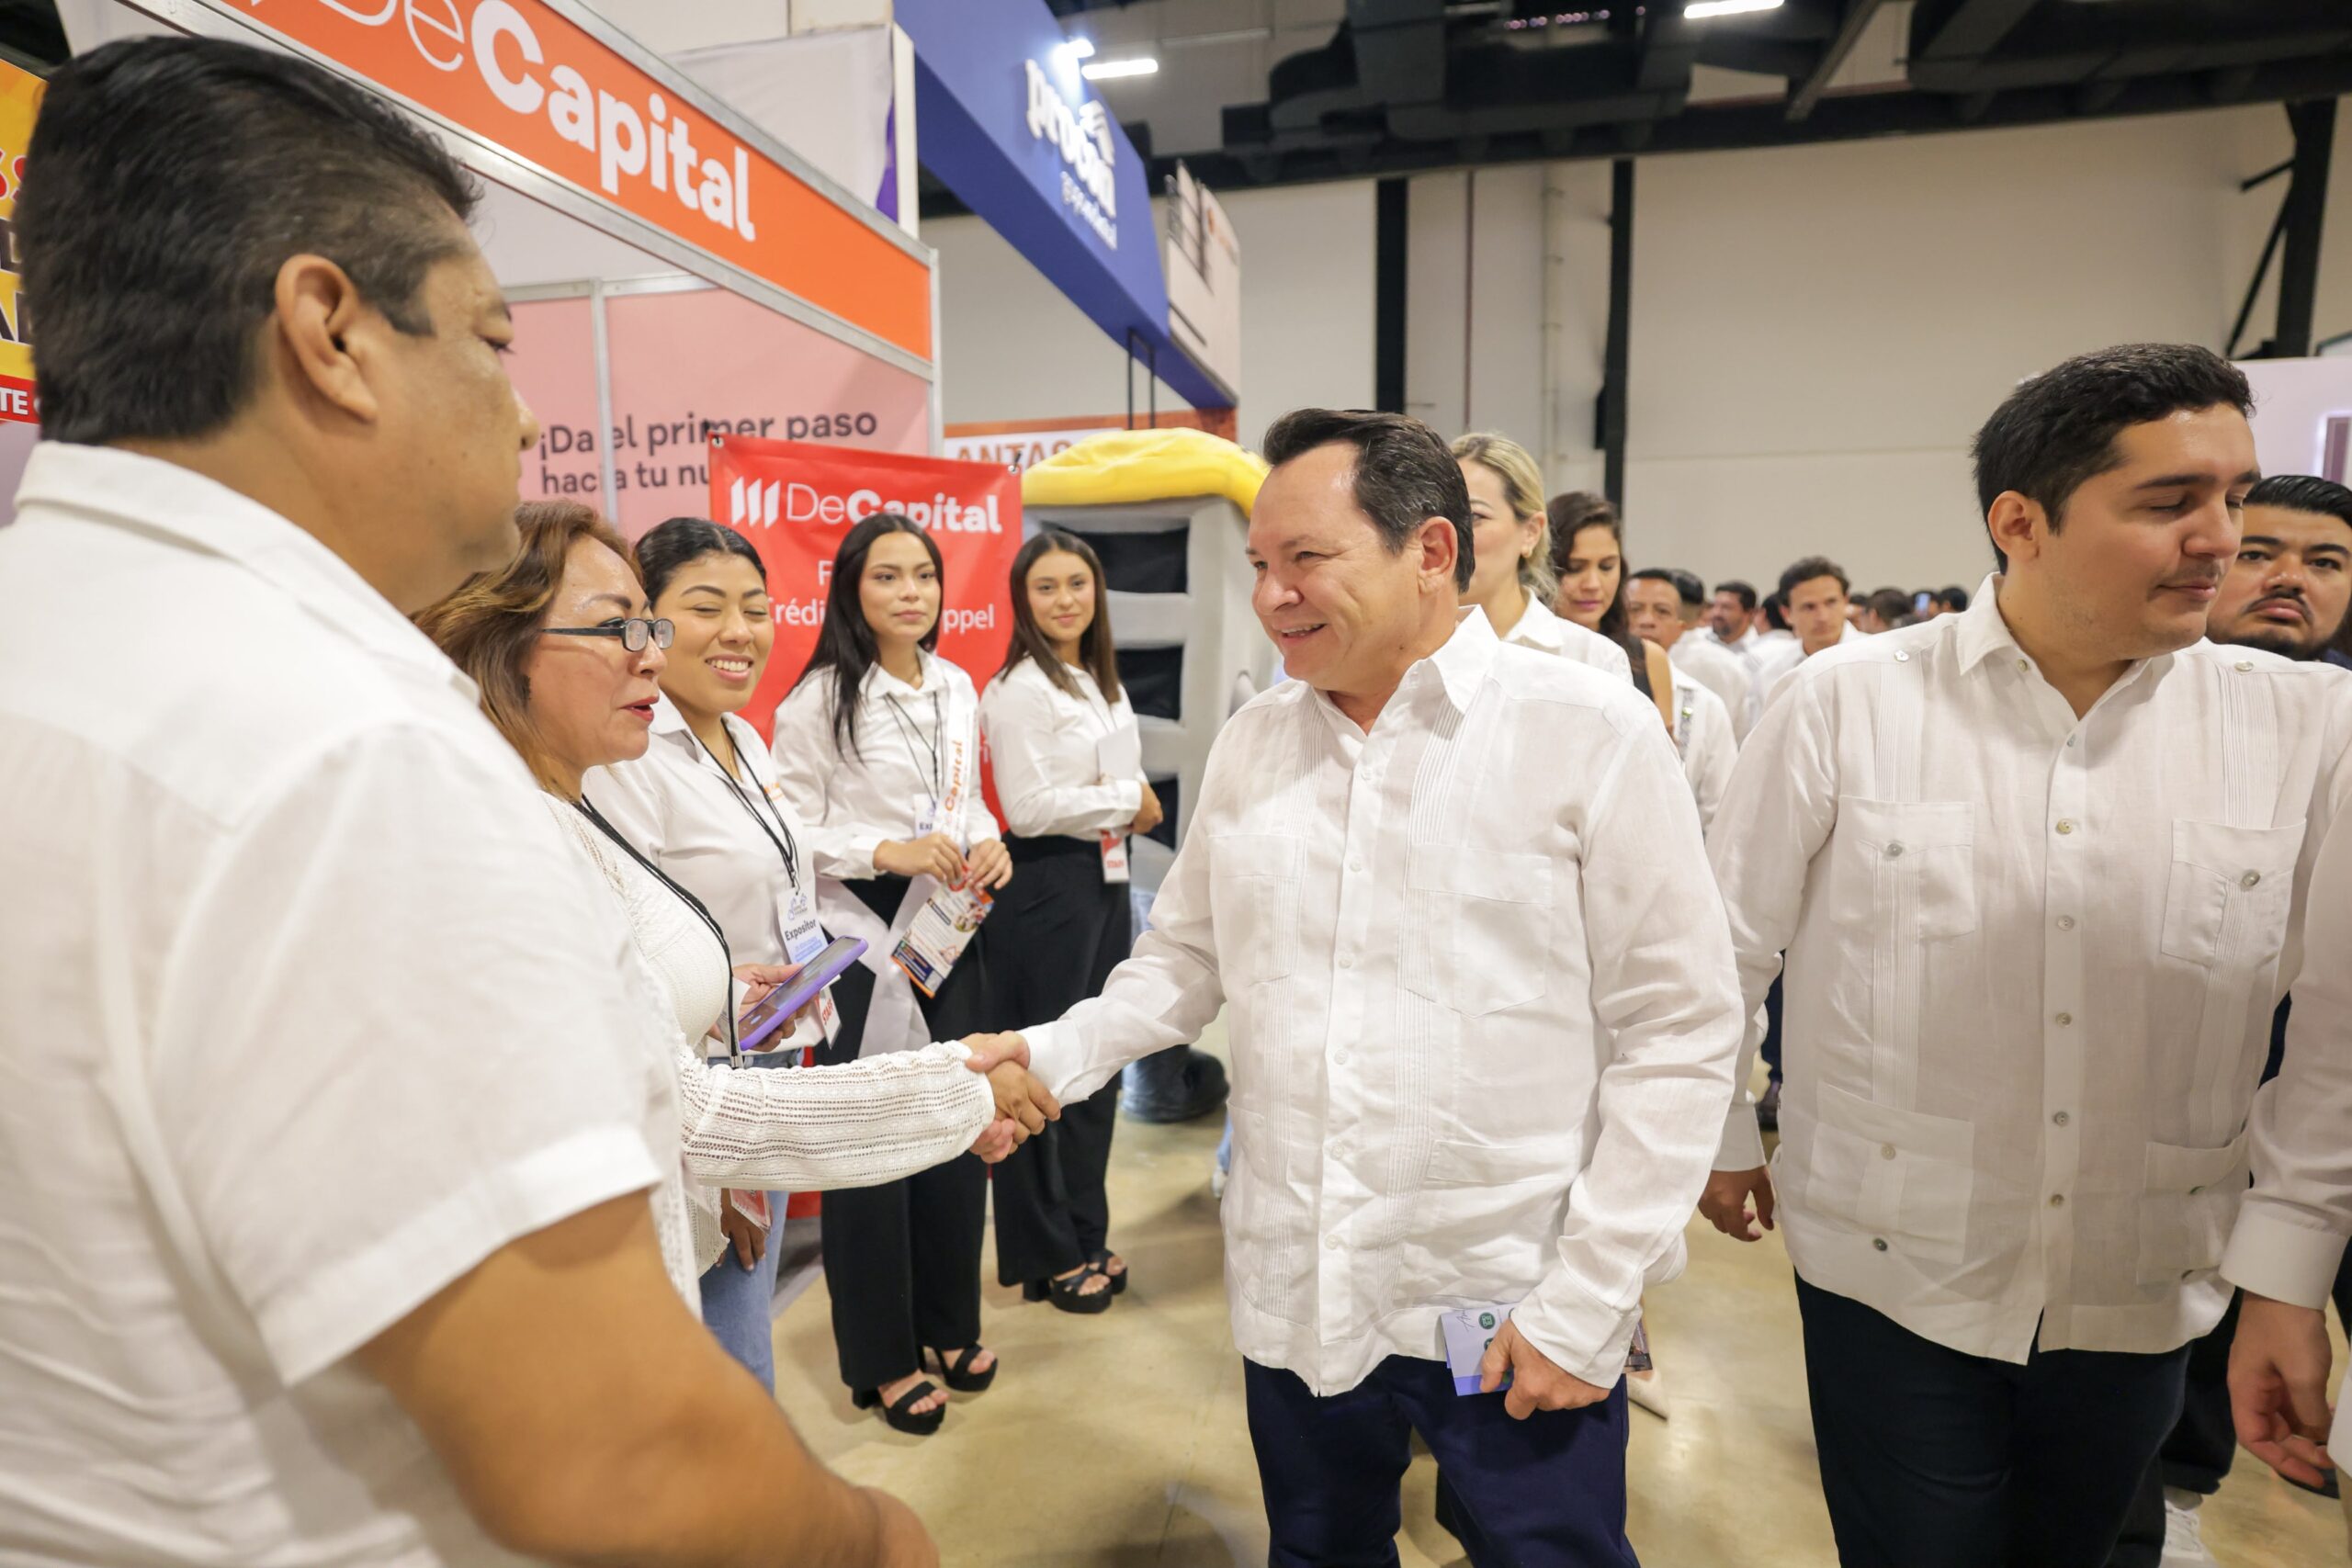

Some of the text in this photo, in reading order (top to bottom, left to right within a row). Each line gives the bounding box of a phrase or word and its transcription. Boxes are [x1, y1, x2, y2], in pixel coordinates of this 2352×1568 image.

[317, 0, 755, 243] eCapital
[540, 411, 876, 460] ¡Da el primer paso
[542, 464, 628, 494] haca
[636, 461, 667, 488] tu
[786, 482, 1003, 534] DeCapital
[768, 597, 826, 626] rédi
[785, 919, 817, 942] Expositor
